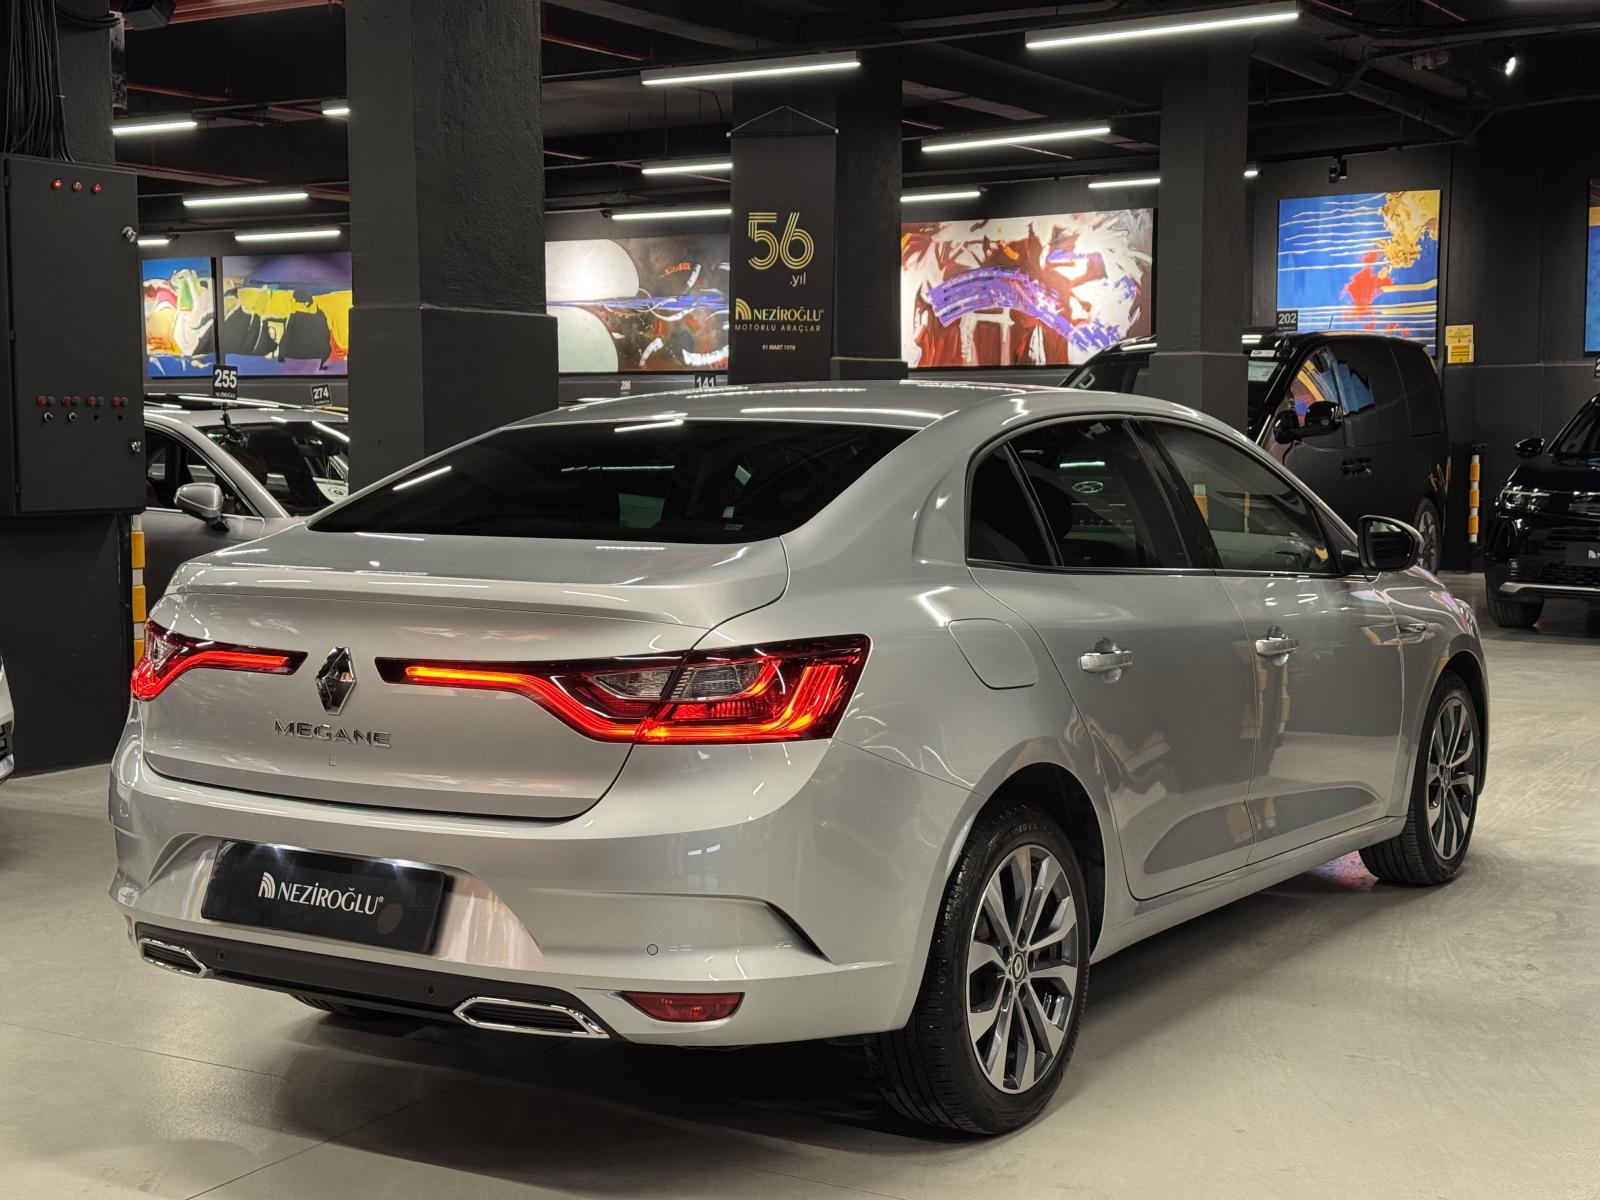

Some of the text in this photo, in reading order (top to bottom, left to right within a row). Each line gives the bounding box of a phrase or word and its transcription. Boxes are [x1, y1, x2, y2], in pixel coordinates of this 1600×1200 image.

[748, 212, 814, 270] 56
[1278, 312, 1297, 325] 202
[735, 324, 821, 333] MOTORLU ARAÇLAR
[214, 368, 238, 389] 255
[696, 376, 715, 389] 141
[312, 386, 330, 400] 274
[274, 719, 392, 748] MEGANE
[277, 881, 380, 916] NEZİROĞLU
